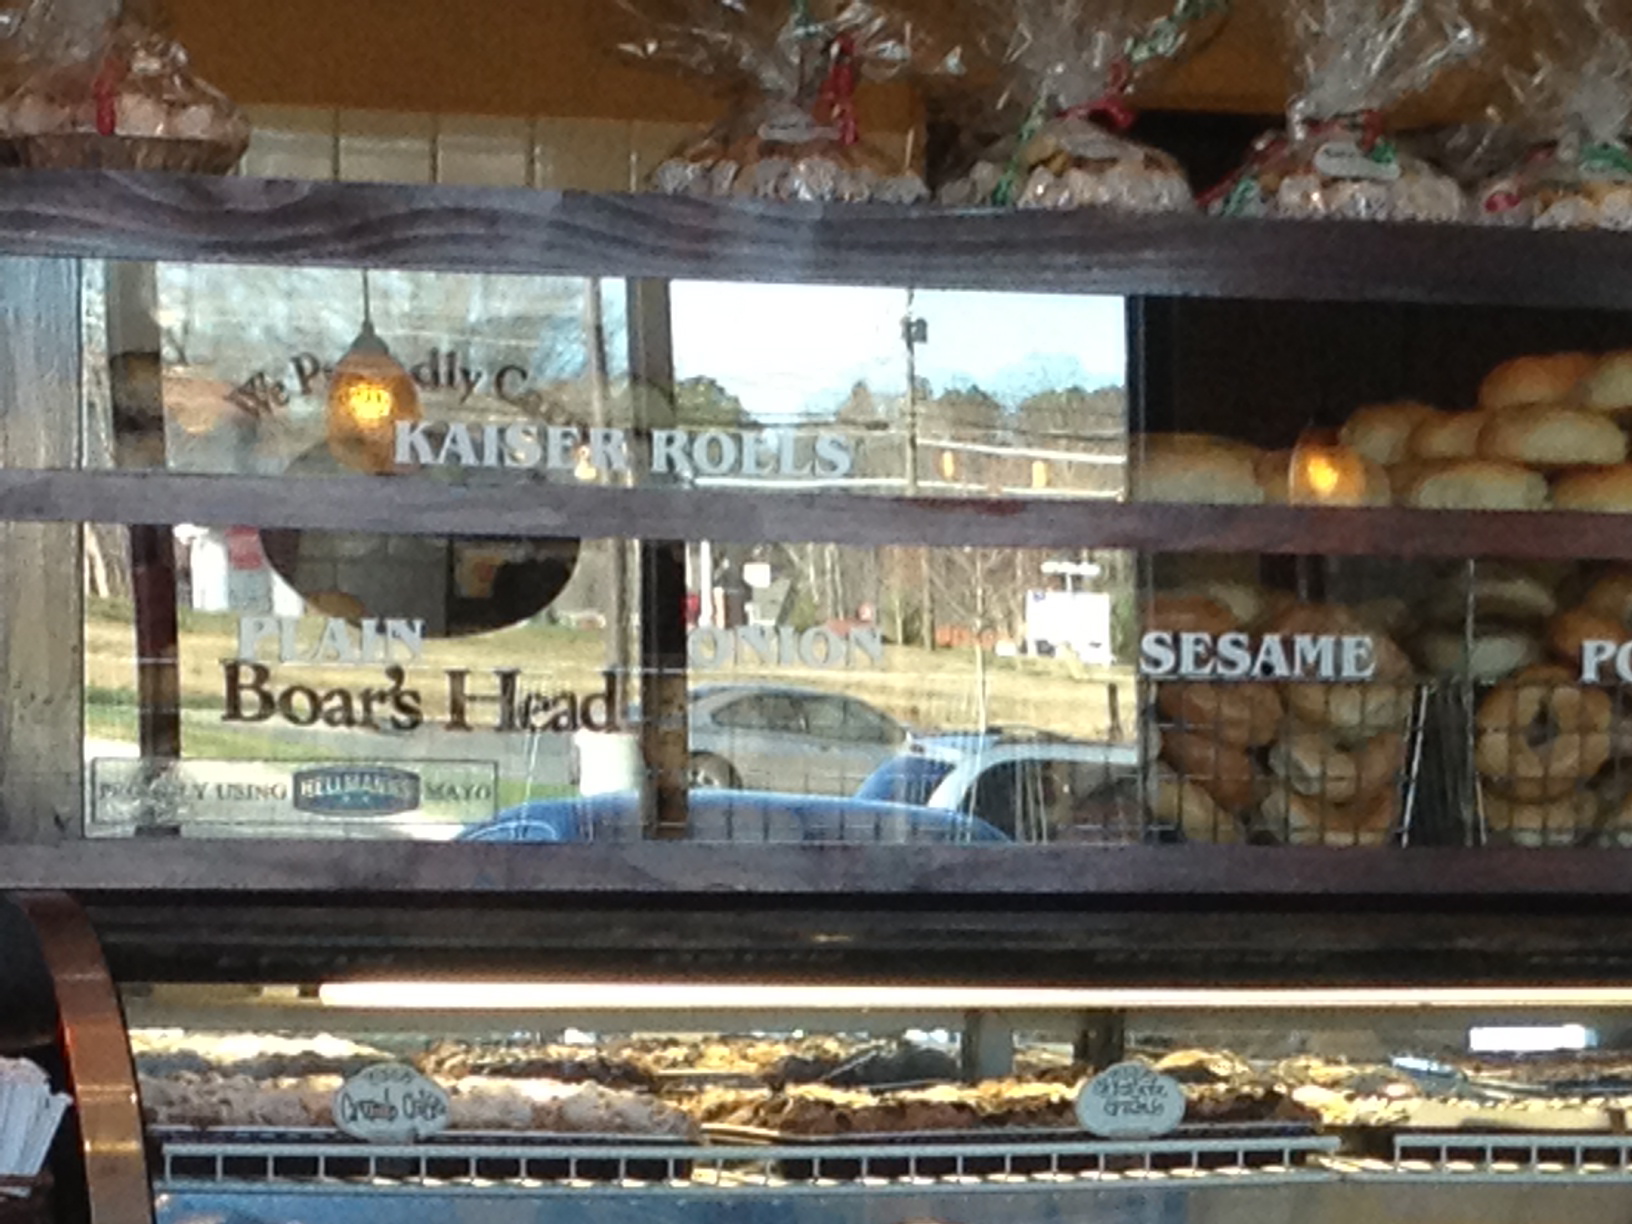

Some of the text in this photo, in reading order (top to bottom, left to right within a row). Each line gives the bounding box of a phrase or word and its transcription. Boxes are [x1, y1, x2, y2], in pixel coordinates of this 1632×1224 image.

[394, 419, 854, 478] KAISER ROLLS
[237, 615, 427, 664] PLAIN
[687, 624, 885, 671] ONION
[1138, 630, 1376, 679] SESAME
[220, 658, 622, 734] Boar's Head
[425, 782, 491, 801] MAYO
